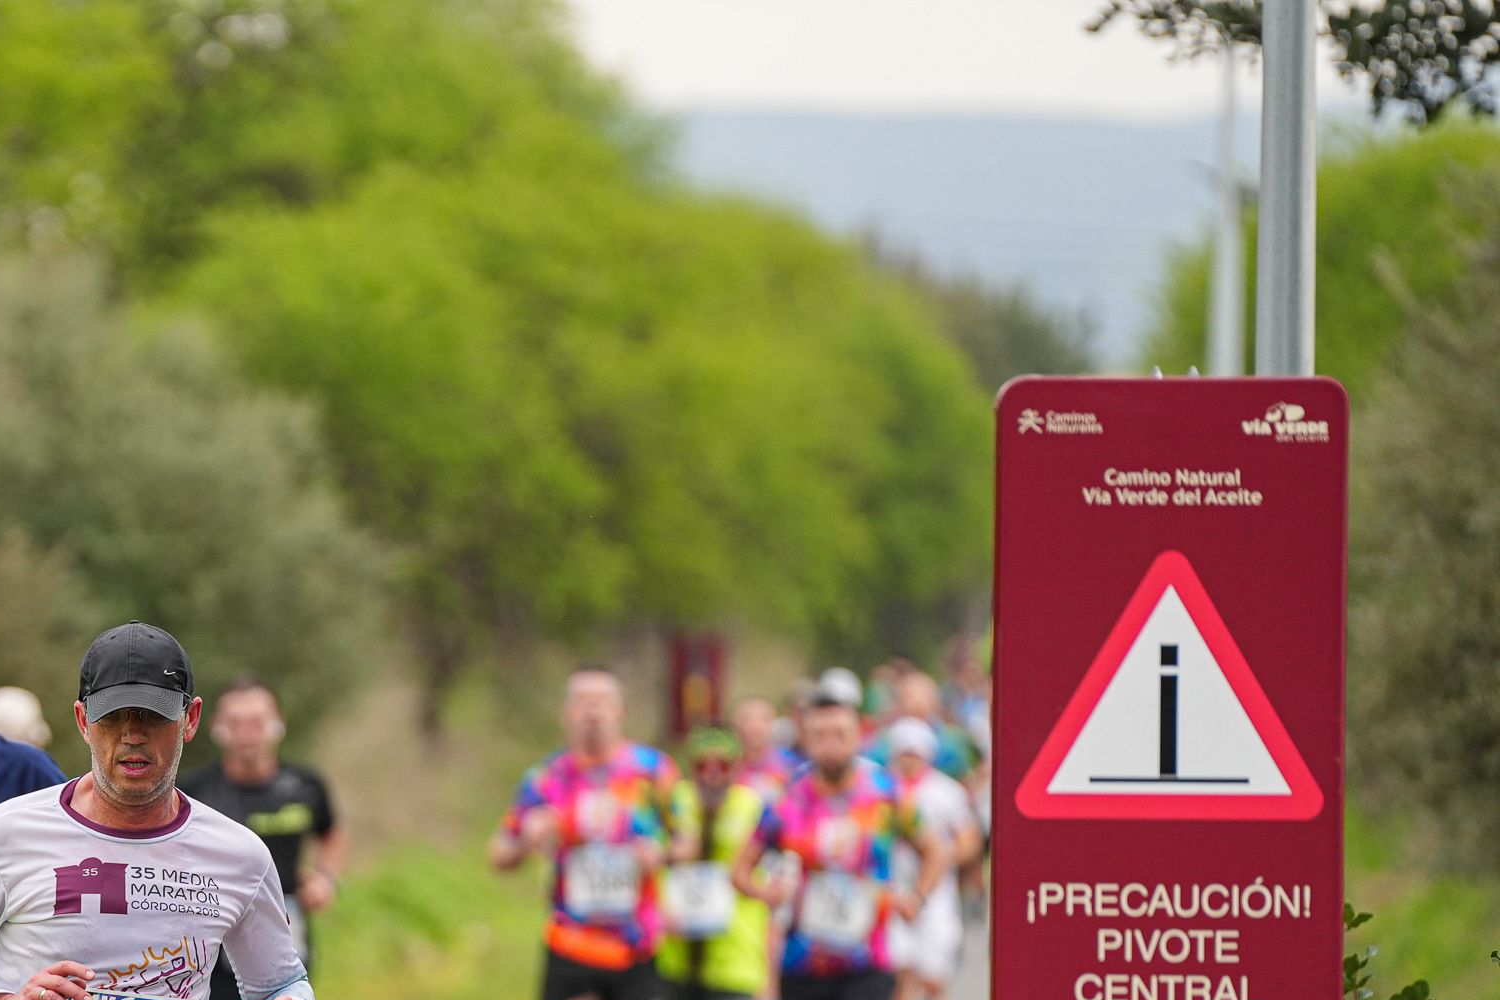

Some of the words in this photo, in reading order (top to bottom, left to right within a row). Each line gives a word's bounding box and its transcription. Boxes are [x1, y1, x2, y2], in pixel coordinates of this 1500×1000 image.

[1275, 421, 1329, 434] VERDE
[1104, 467, 1172, 487] Camino
[1175, 468, 1241, 487] Natural
[1115, 487, 1169, 506] Verde
[1172, 487, 1201, 506] del
[1204, 487, 1263, 506] Aceite
[82, 867, 99, 877] 35
[130, 866, 156, 879] 35
[162, 868, 219, 890] MEDIA
[130, 883, 220, 906] MARATÓN
[1026, 876, 1311, 924] ¡PRECAUCIÓN!
[1097, 928, 1240, 964] PIVOTE
